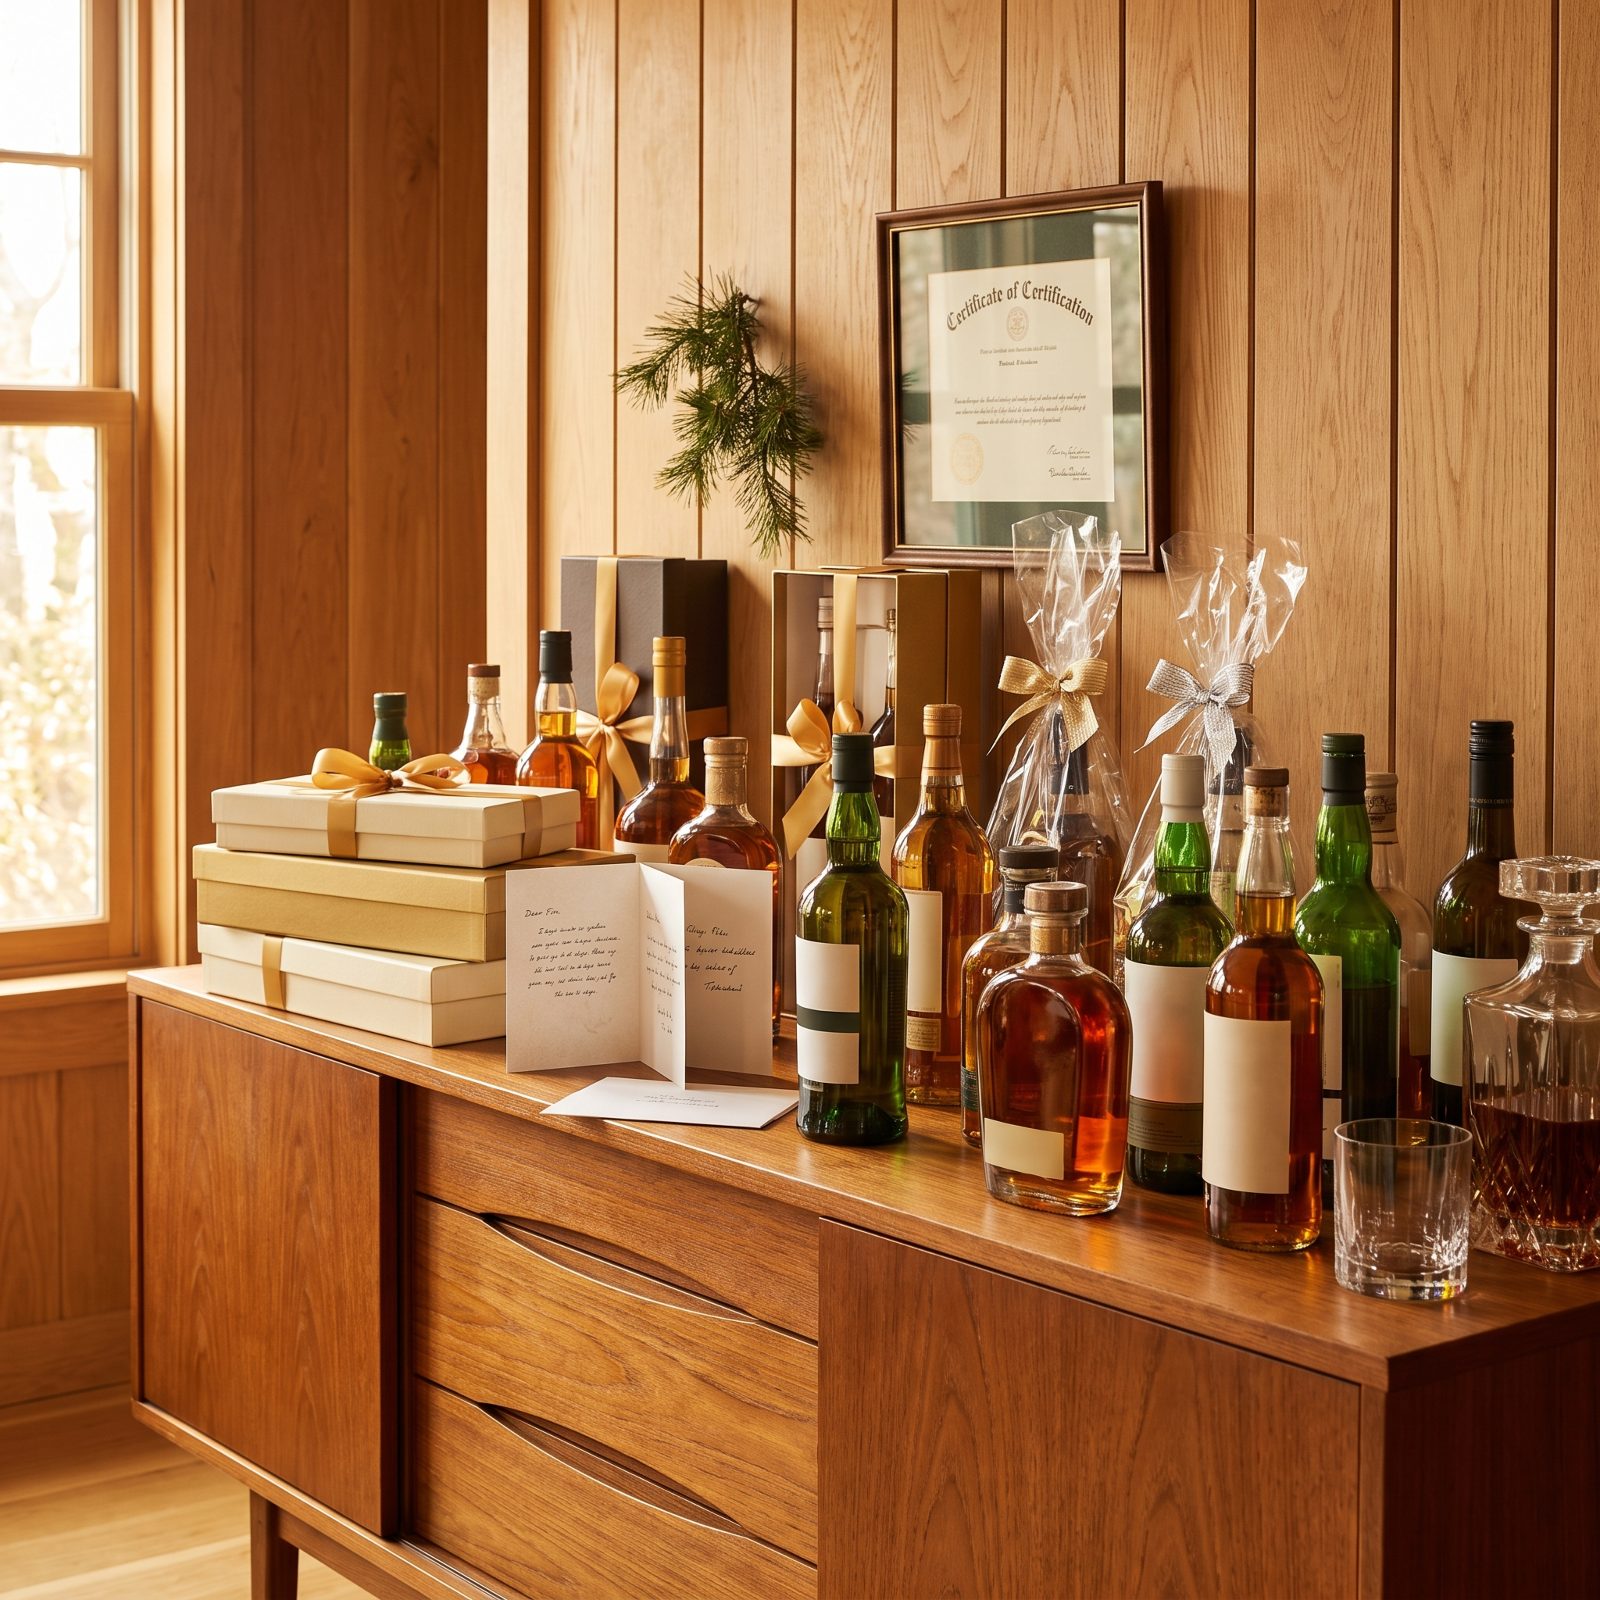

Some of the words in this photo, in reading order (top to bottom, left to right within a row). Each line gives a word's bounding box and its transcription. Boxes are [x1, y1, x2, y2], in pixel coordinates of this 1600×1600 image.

[946, 287, 1003, 331] Certificate
[1006, 280, 1020, 301] of
[1021, 280, 1094, 326] Certification
